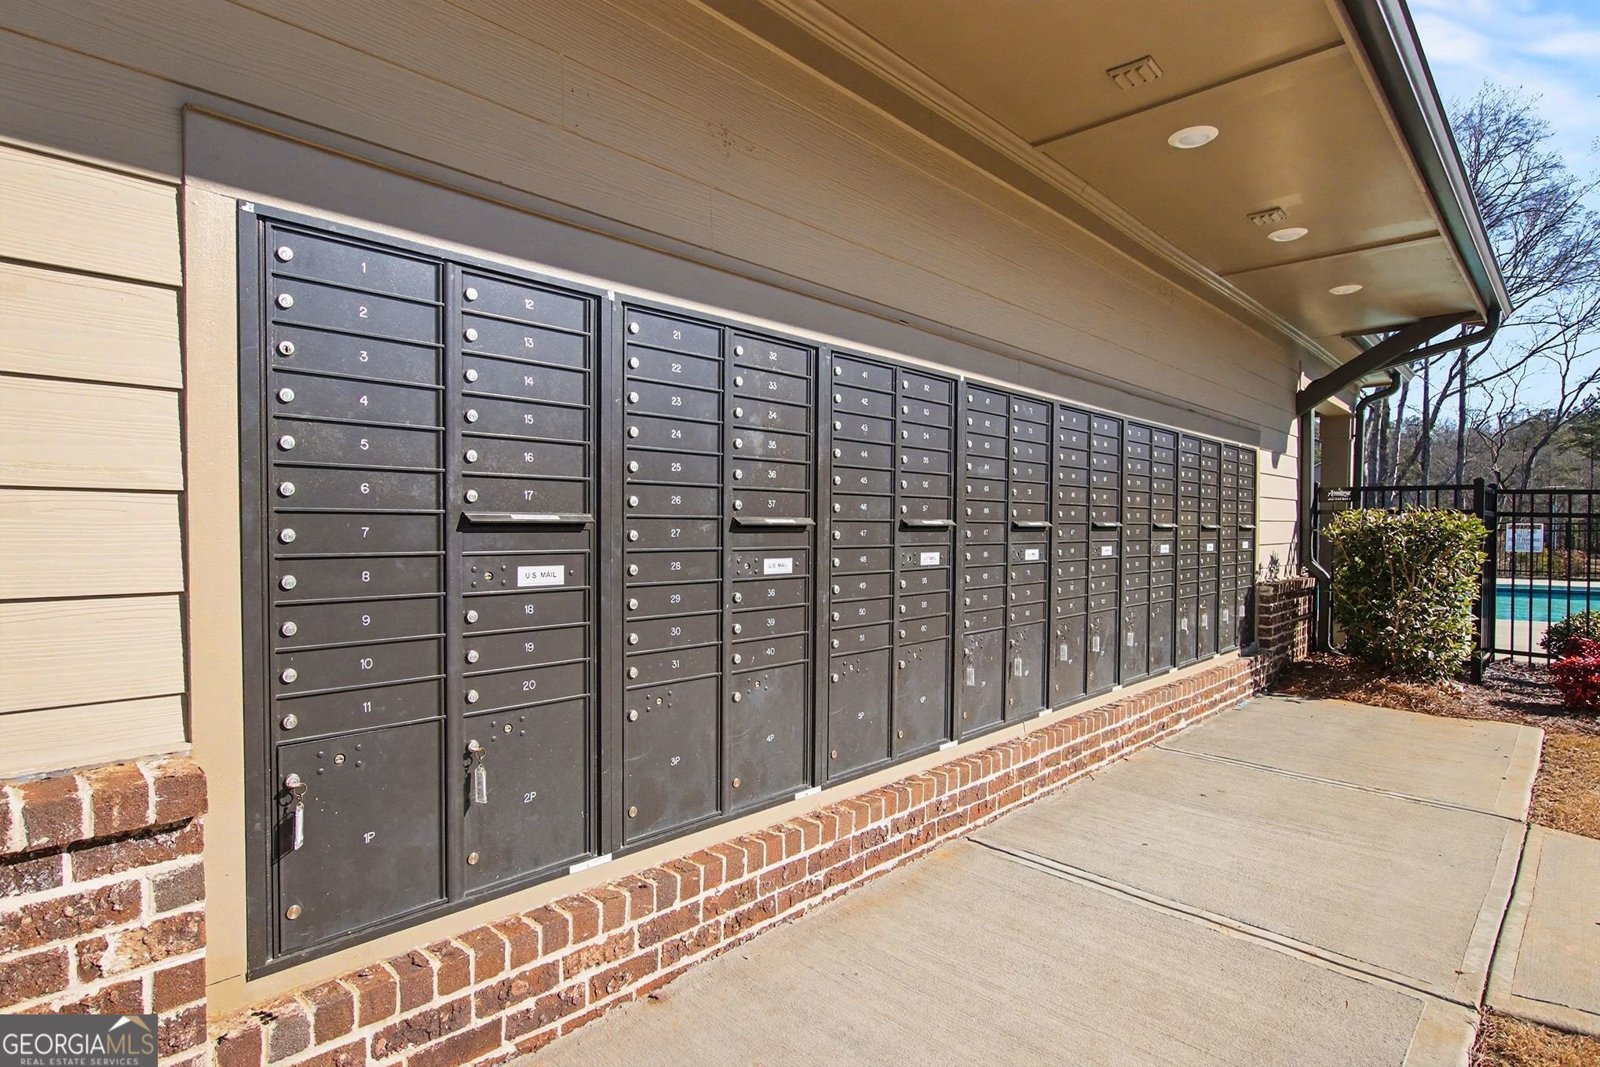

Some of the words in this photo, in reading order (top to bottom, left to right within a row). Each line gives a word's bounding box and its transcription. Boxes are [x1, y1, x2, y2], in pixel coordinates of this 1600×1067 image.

[360, 262, 367, 274] 1
[524, 298, 534, 310] 12
[359, 305, 368, 319] 2
[672, 330, 681, 340] 21
[523, 336, 535, 348] 13
[359, 350, 369, 363] 3
[768, 351, 778, 361] 32
[671, 362, 682, 373] 22
[524, 375, 535, 387] 14
[768, 380, 778, 390] 33
[359, 395, 369, 407] 4
[671, 396, 682, 407] 23
[523, 414, 534, 425] 15
[767, 410, 777, 420] 34
[671, 429, 682, 439] 24
[359, 438, 370, 451] 5
[767, 440, 777, 449] 35
[523, 452, 535, 463] 16
[671, 462, 682, 472] 25
[767, 469, 777, 479] 36
[360, 482, 370, 494] 6
[524, 490, 534, 501] 17
[671, 495, 682, 505] 26
[767, 499, 776, 508] 37
[361, 526, 370, 538] 7
[670, 528, 681, 538] 27
[670, 561, 682, 571] 28
[361, 570, 371, 582] 8
[767, 588, 776, 597] 38
[670, 593, 681, 604] 29
[524, 604, 535, 615] 18
[361, 614, 371, 626] 9
[766, 617, 776, 627] 39
[670, 626, 682, 637] 30
[524, 642, 535, 653] 19
[765, 647, 776, 656] 40
[360, 657, 374, 670] 10
[671, 659, 680, 669] 31
[522, 679, 537, 691] 20
[362, 701, 372, 713] 11
[670, 756, 681, 767] 3P
[523, 791, 537, 804] 2P
[363, 831, 376, 844] 1P
